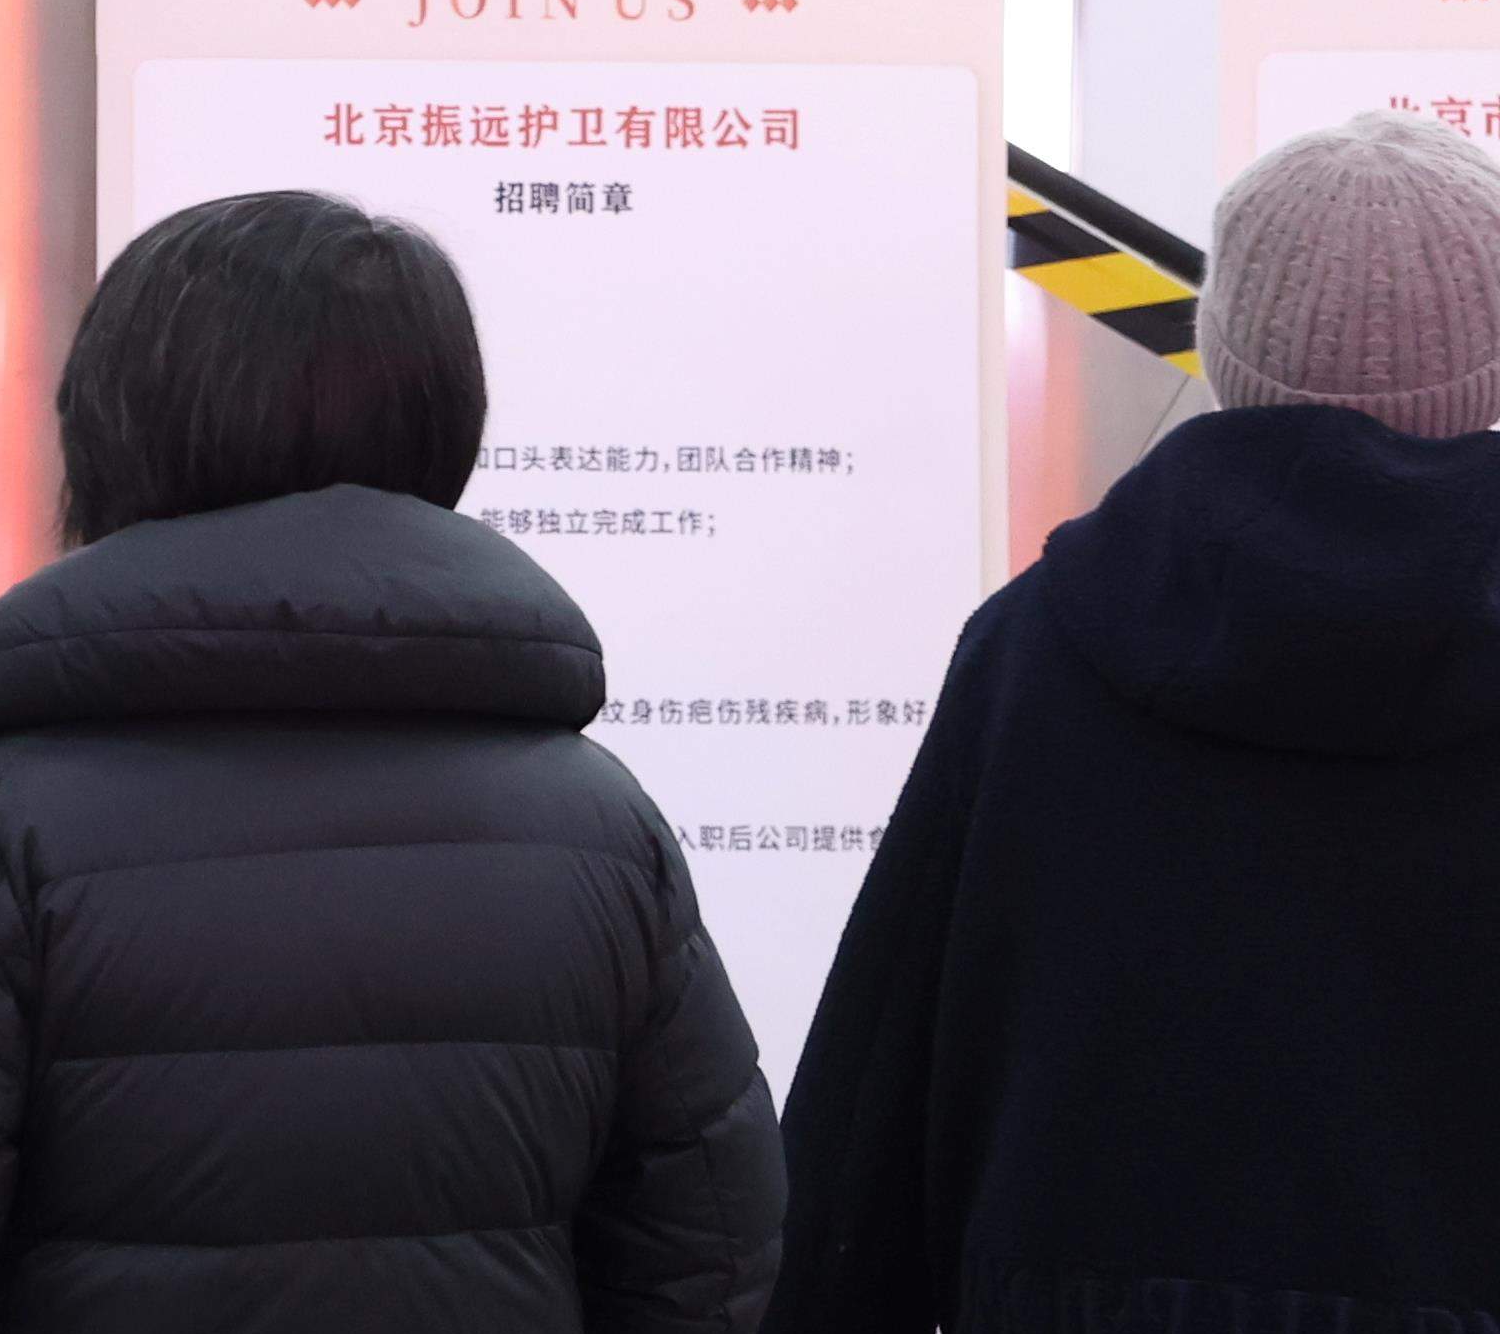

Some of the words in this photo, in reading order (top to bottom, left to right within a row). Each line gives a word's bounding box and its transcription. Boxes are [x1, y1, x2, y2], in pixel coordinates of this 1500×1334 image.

[323, 102, 802, 151] 北京振远护卫有限公司
[494, 180, 634, 216] 招聘简章
